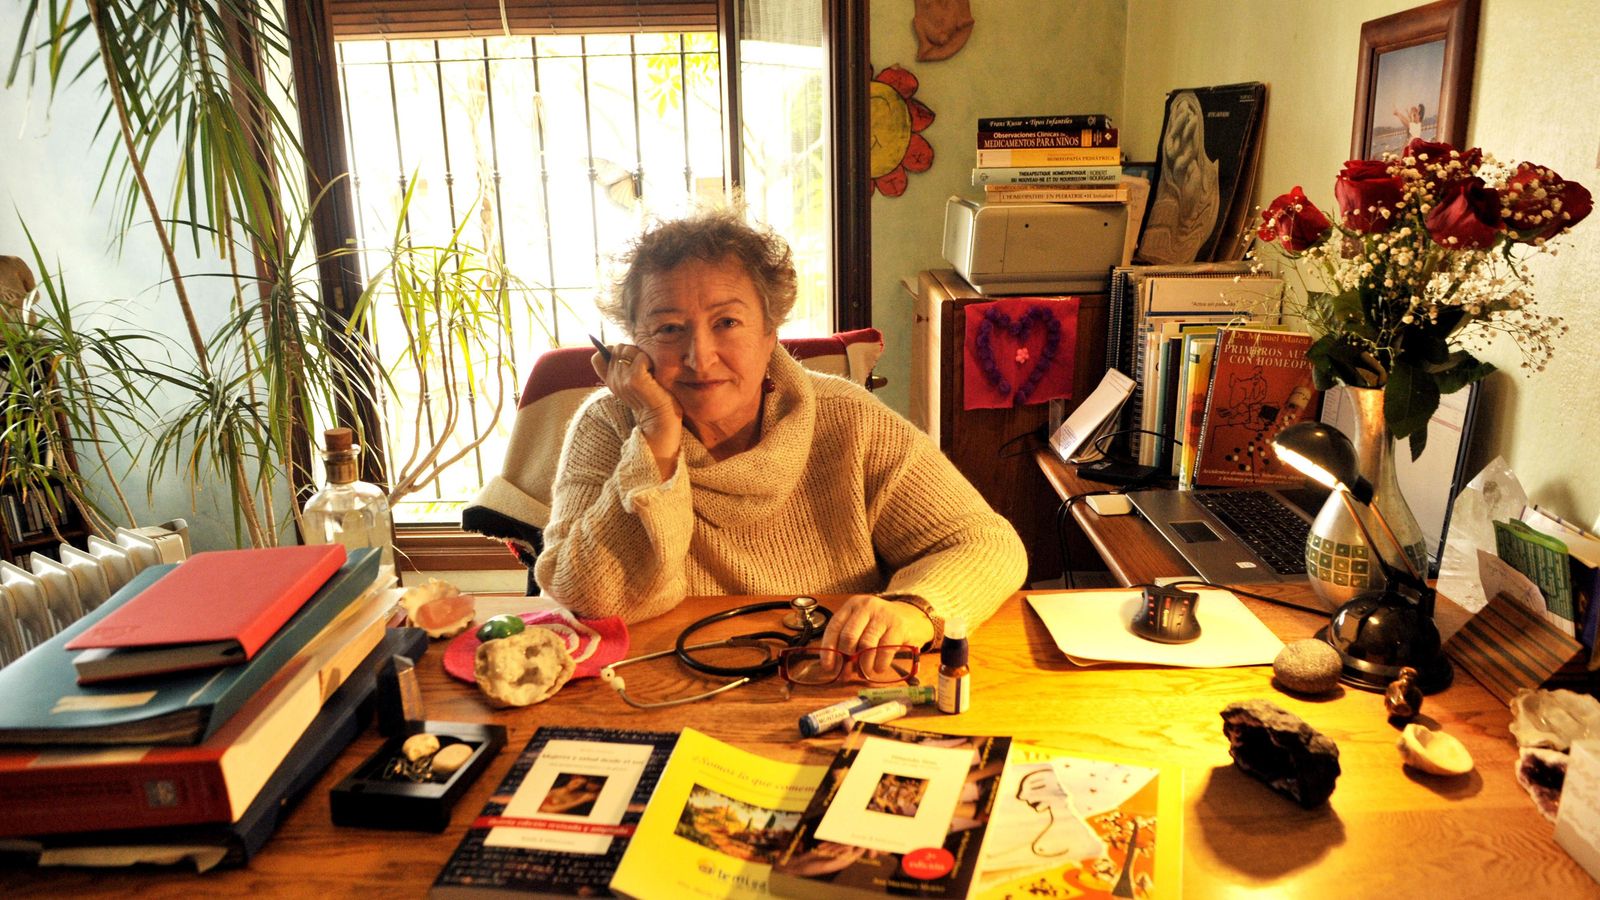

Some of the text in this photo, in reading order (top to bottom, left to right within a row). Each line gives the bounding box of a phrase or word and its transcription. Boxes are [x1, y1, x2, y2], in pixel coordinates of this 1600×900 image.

[1045, 117, 1073, 126] Infantiles
[983, 135, 1079, 148] MEDICAMENTOS PARA NIÑOS
[1281, 335, 1310, 345] Mateu
[1229, 353, 1253, 365] CON
